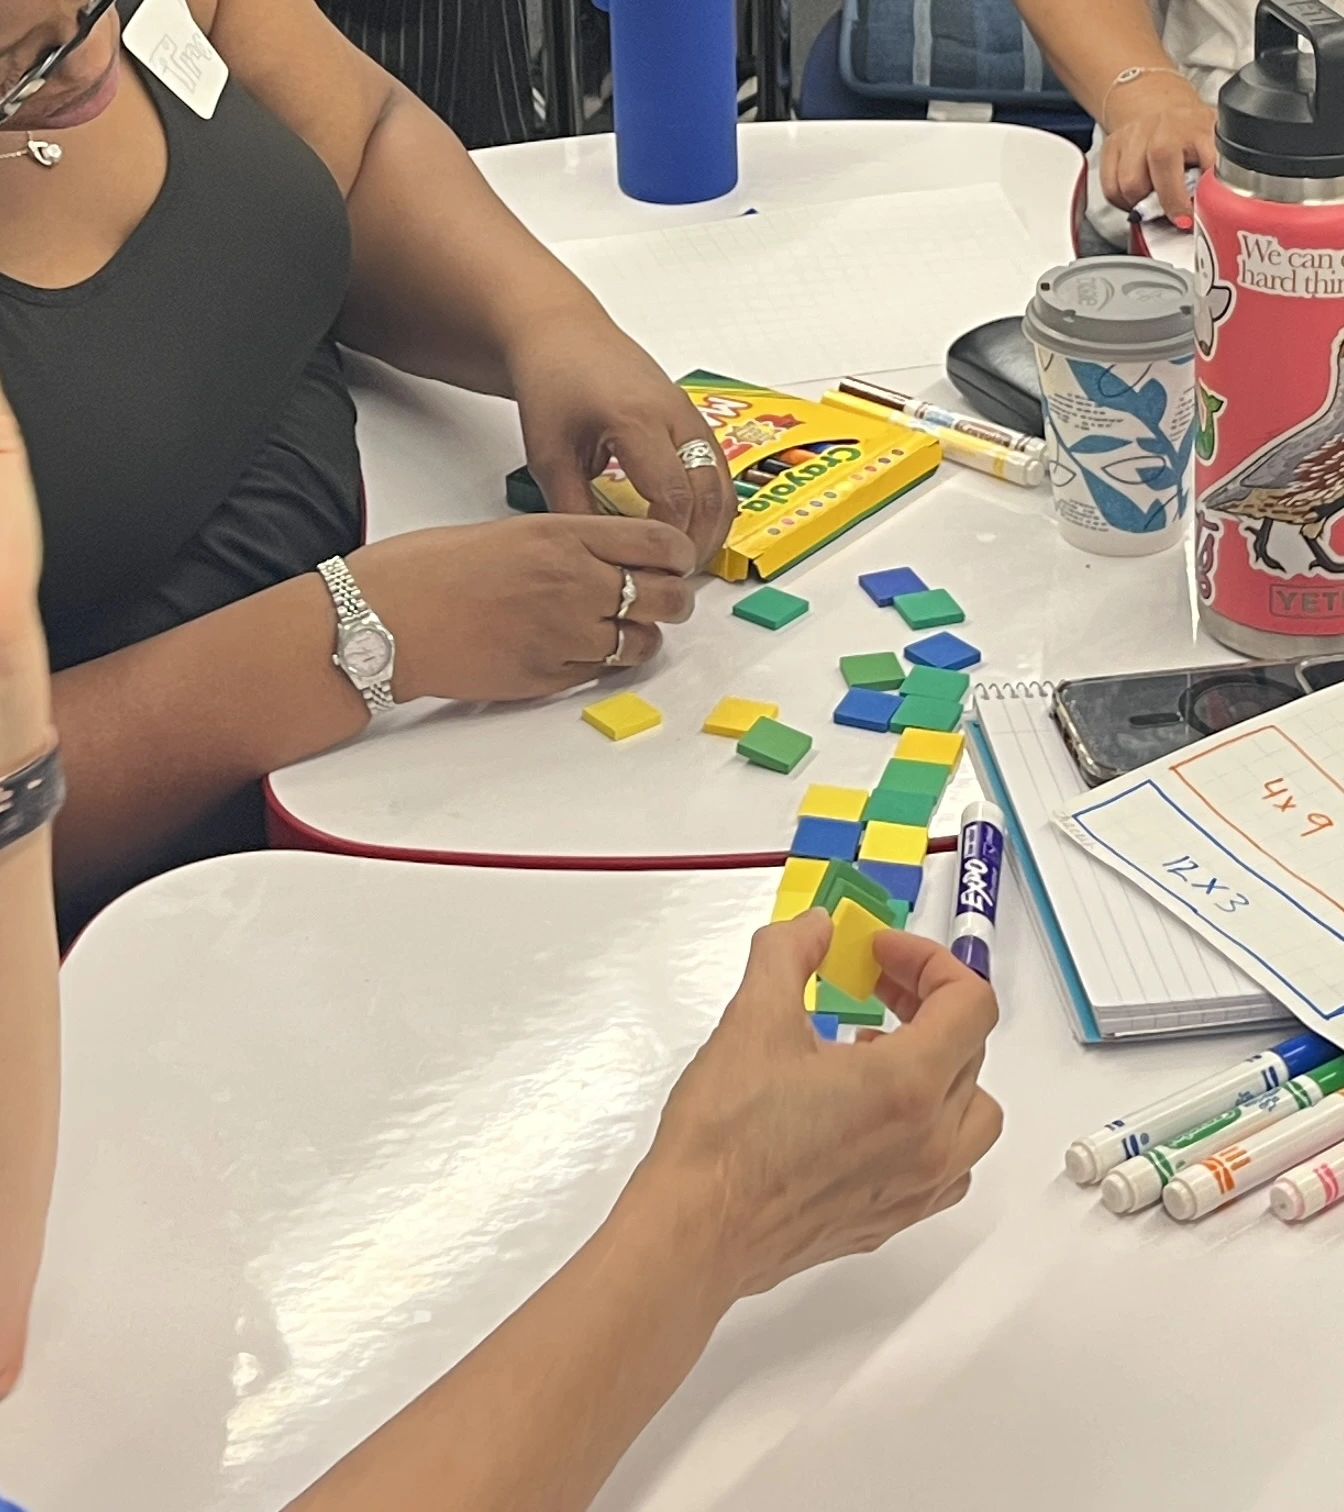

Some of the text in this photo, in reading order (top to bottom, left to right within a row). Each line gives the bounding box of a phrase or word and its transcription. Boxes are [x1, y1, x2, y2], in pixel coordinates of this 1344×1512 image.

[1242, 234, 1282, 266] We
[1288, 251, 1333, 270] can
[1242, 260, 1297, 293] hard
[741, 446, 862, 513] Crayola
[960, 858, 994, 912] EXPO
